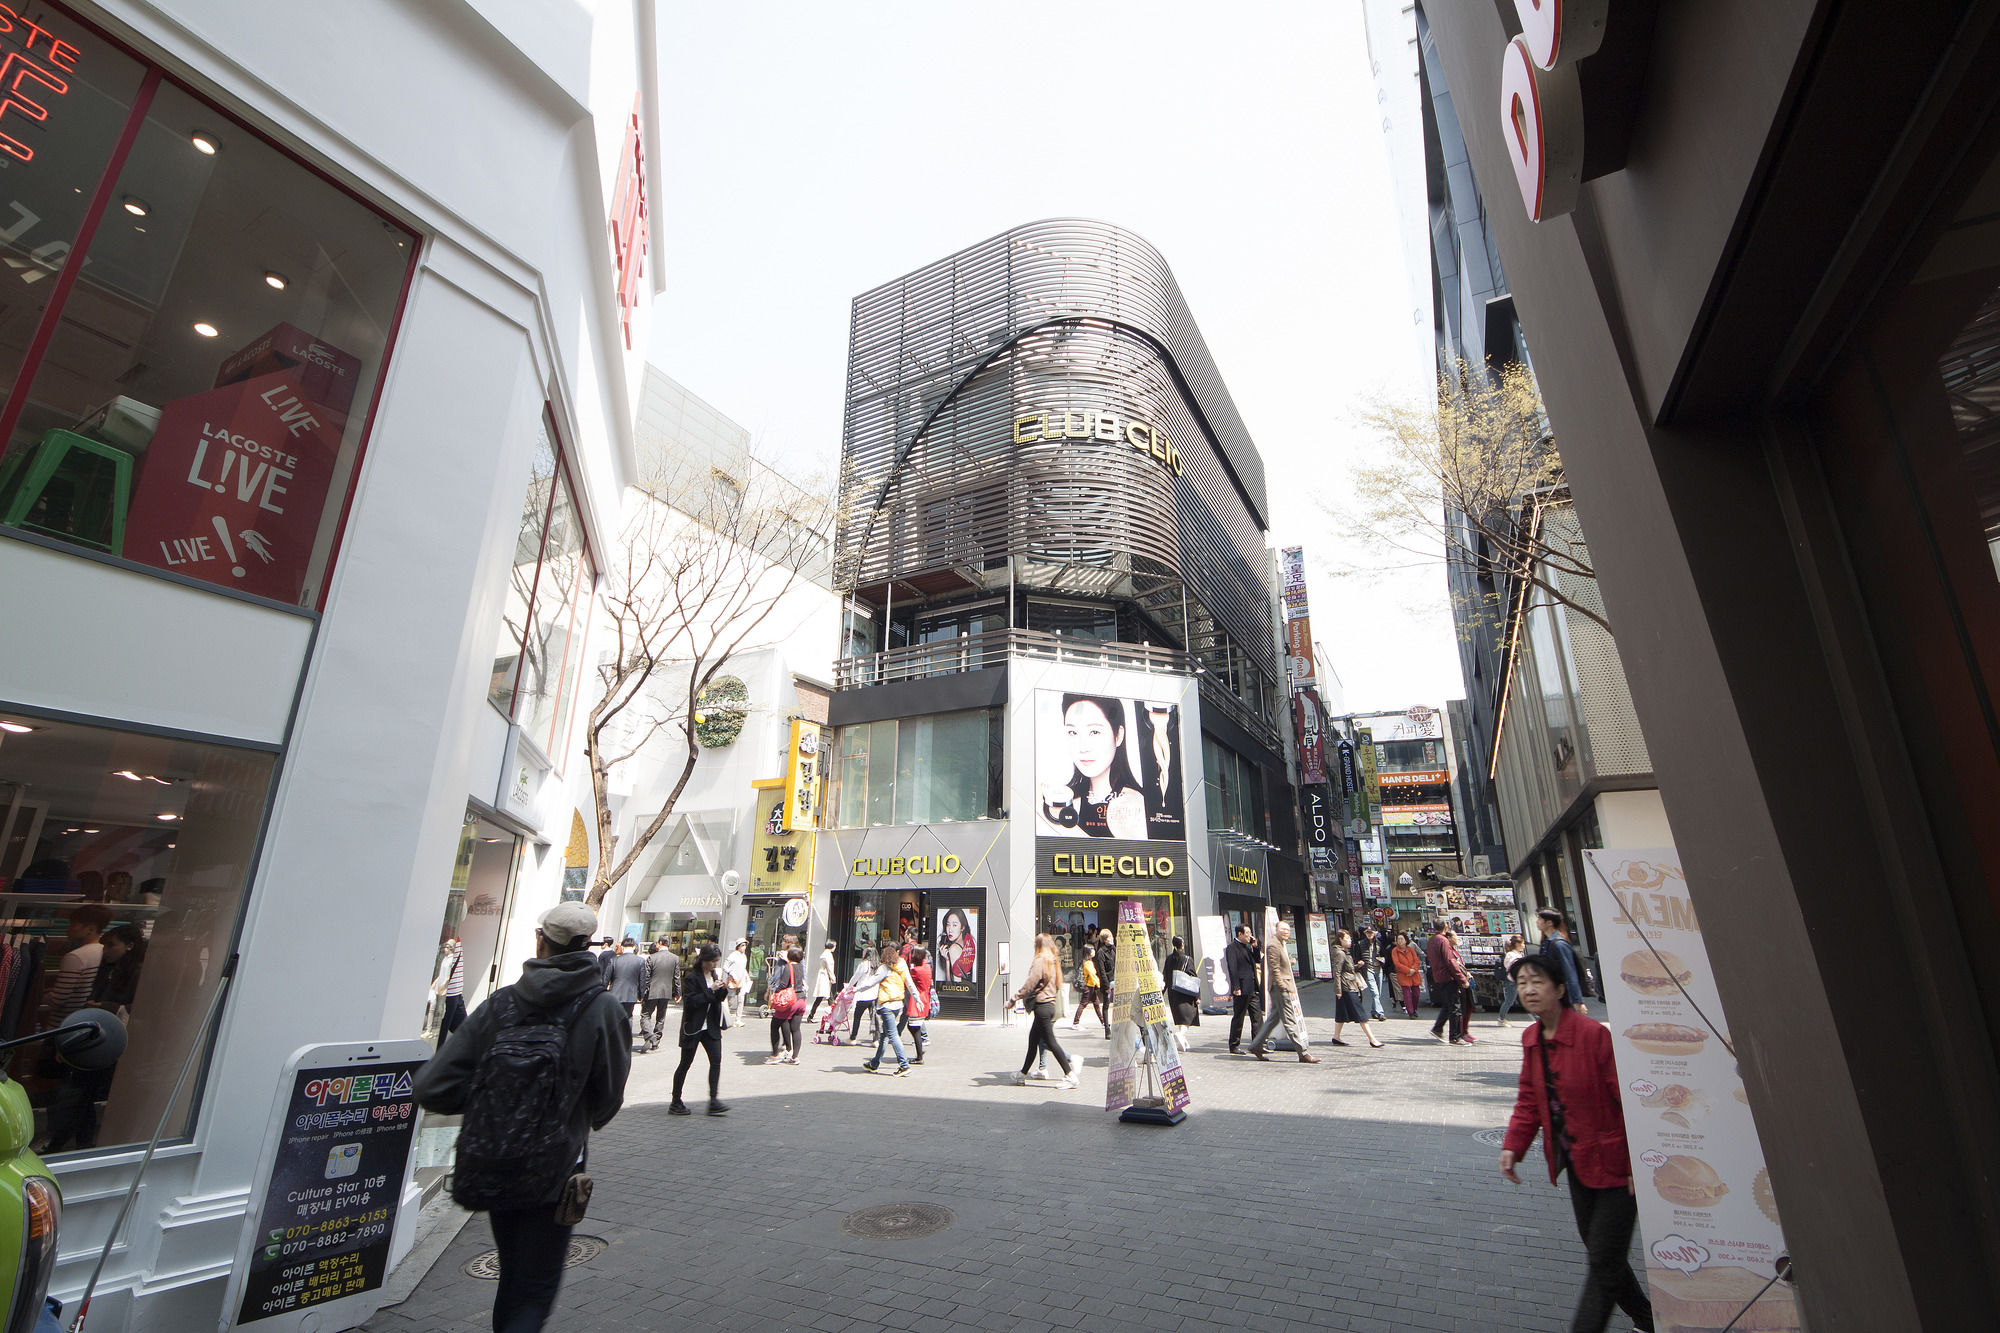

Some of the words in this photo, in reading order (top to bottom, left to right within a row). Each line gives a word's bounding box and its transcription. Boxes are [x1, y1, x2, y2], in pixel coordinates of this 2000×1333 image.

[292, 345, 345, 377] LACOSTE
[202, 422, 298, 469] LACOSTE
[1381, 775, 1411, 784] HAN'S
[1311, 793, 1326, 841] ALDO
[305, 1070, 414, 1106] 아이폰픽스
[296, 1108, 368, 1130] 아이폰수리
[372, 1103, 412, 1120] 하우징
[311, 1134, 329, 1142] repair
[287, 1187, 333, 1202] Culture
[336, 1182, 359, 1194] Star
[364, 1175, 387, 1189] 10층
[297, 1199, 332, 1216] 매장내
[335, 1192, 371, 1209] EV이용
[286, 1208, 388, 1239] 070-8863-6153
[283, 1223, 385, 1255] 070-8882-7890
[282, 1263, 315, 1279] 아이폰
[319, 1252, 360, 1271] 액정수리
[262, 1295, 296, 1312] 아이폰
[300, 1283, 342, 1304] 중고매입
[345, 1277, 366, 1292] 판매
[271, 1279, 305, 1295] 아이폰
[308, 1271, 340, 1287] 배터리
